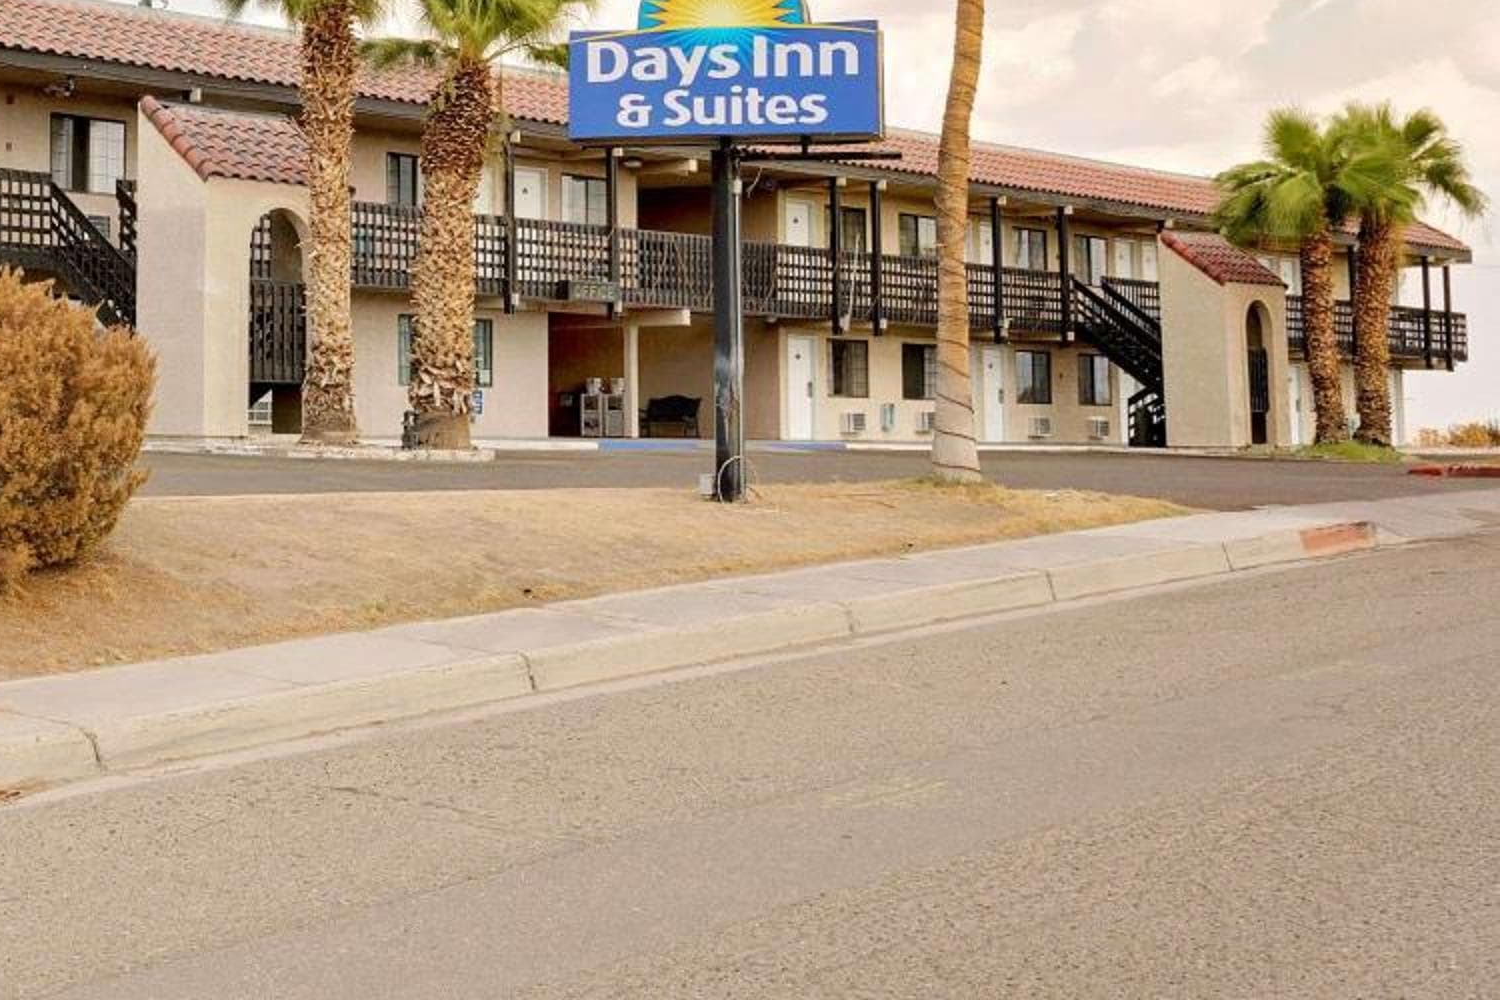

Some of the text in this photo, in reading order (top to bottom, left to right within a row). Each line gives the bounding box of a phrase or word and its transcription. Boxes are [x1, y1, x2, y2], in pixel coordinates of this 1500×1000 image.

[587, 35, 859, 86] Days Inn
[616, 85, 829, 128] & Suites
